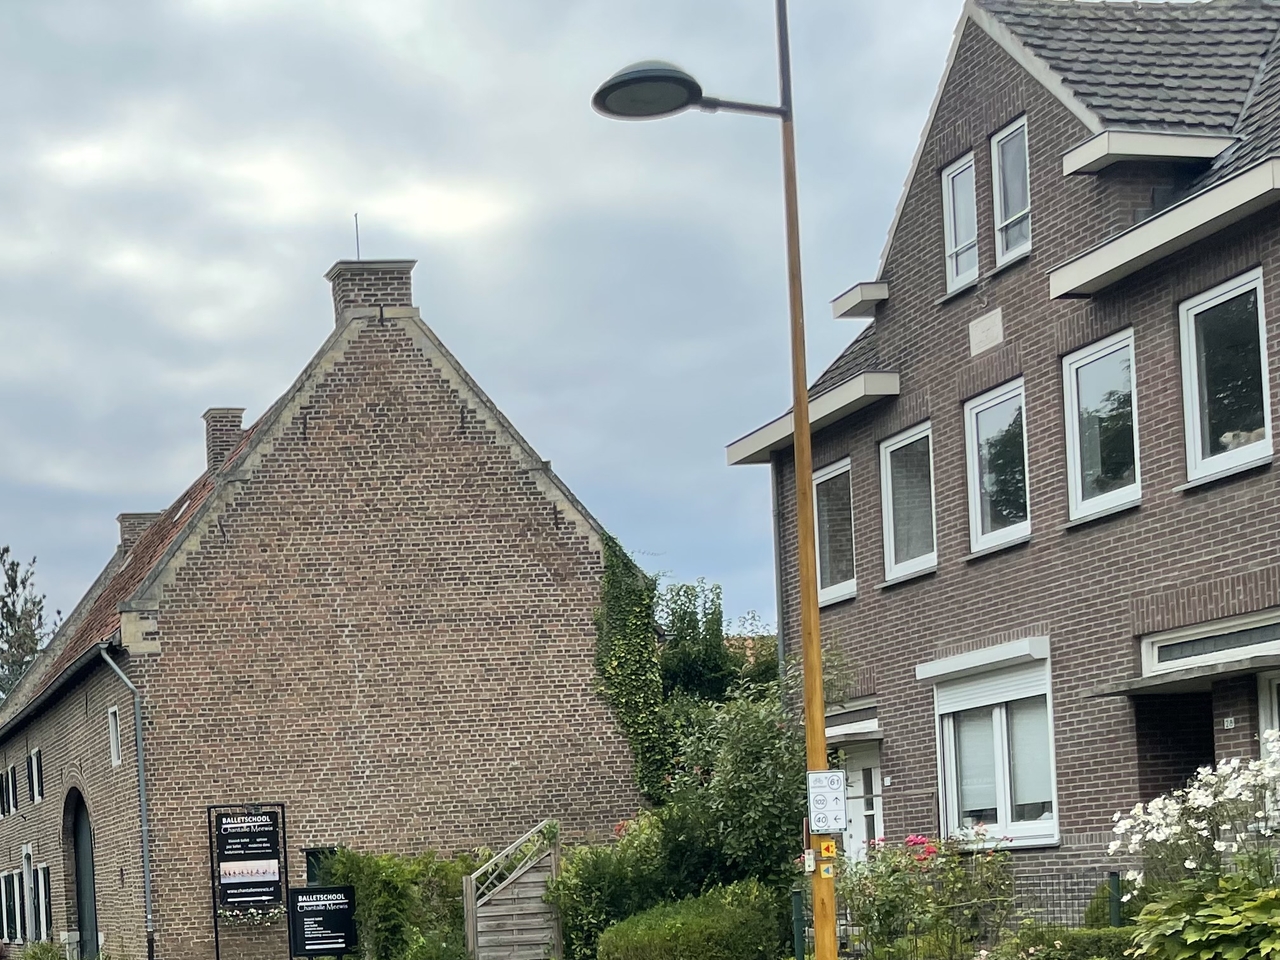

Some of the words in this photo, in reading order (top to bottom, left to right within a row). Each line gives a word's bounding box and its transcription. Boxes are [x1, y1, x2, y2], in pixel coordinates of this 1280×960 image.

[1225, 719, 1233, 728] 28
[829, 778, 840, 786] 61
[222, 815, 271, 824] BALLETSCHOOL
[815, 816, 827, 824] 40
[298, 893, 345, 902] BALLETSCHOOL
